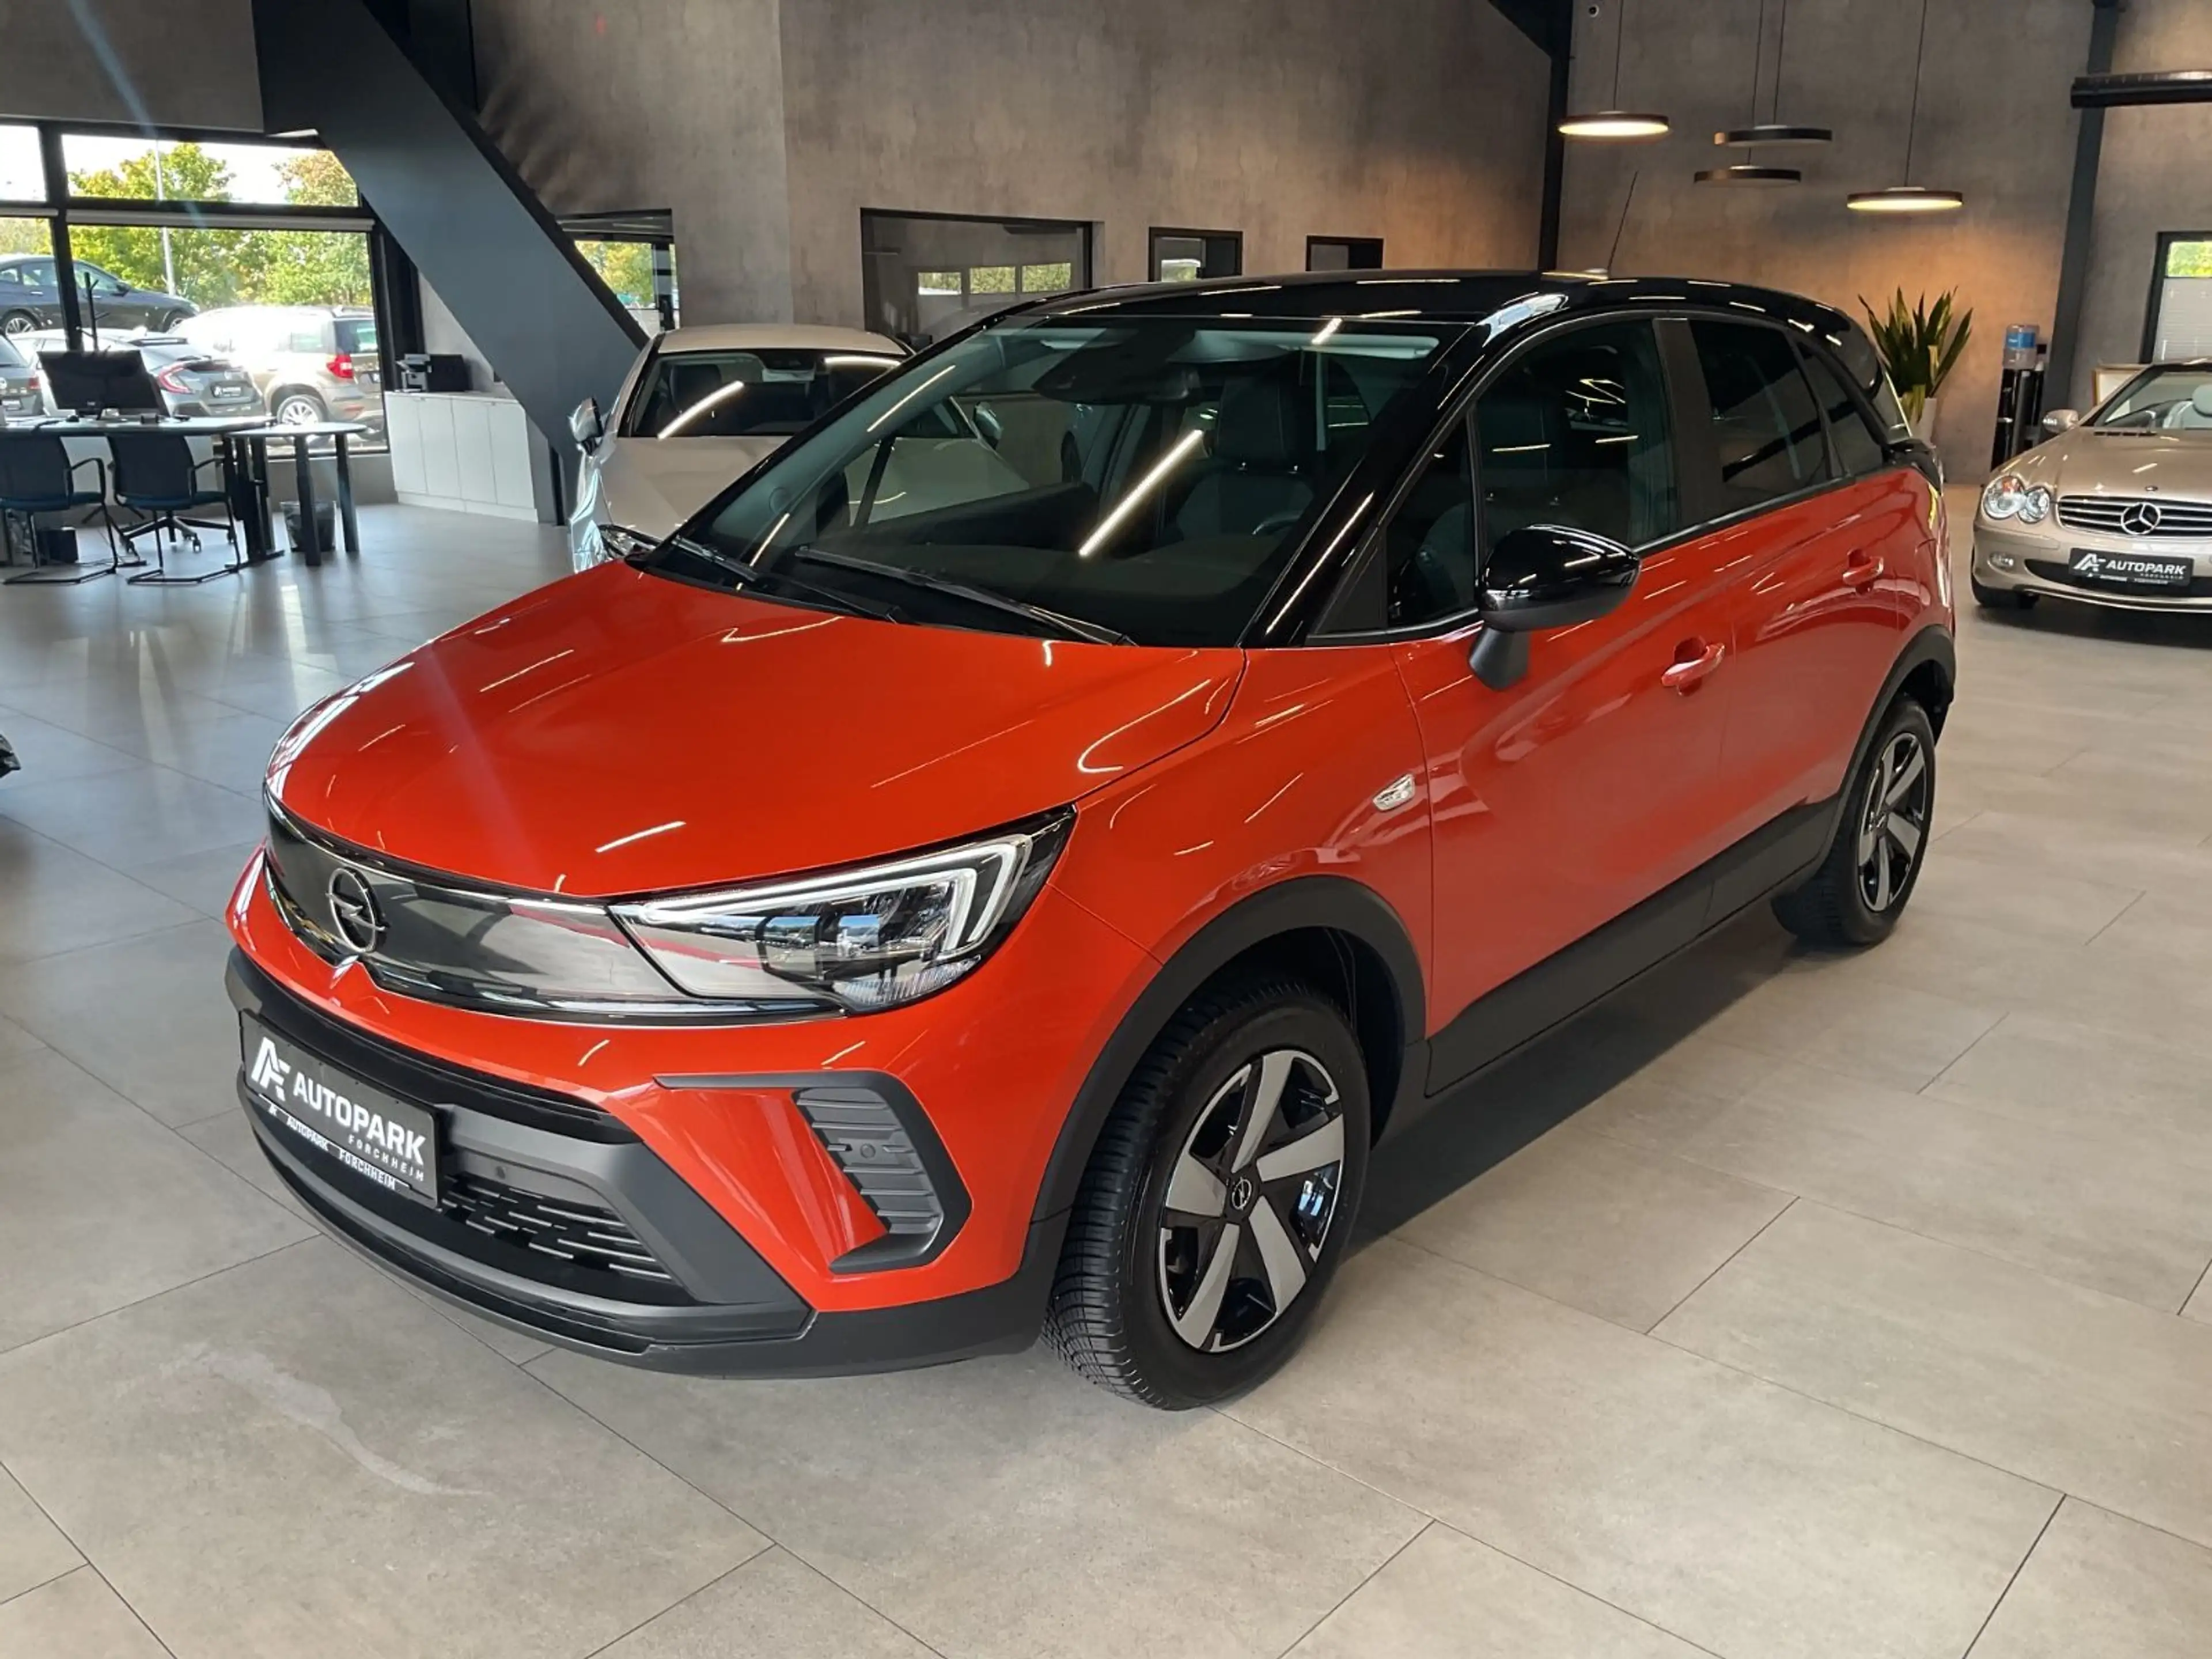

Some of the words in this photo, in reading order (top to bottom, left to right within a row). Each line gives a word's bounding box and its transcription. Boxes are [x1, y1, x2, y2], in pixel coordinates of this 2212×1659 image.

[2105, 559, 2187, 575] AUTOPARK
[293, 1071, 426, 1165] AUTOPARK
[286, 1115, 329, 1152] AUTOPARK
[338, 1148, 396, 1191] FORCHHEIM
[348, 1135, 425, 1182] FORCHHEIM
